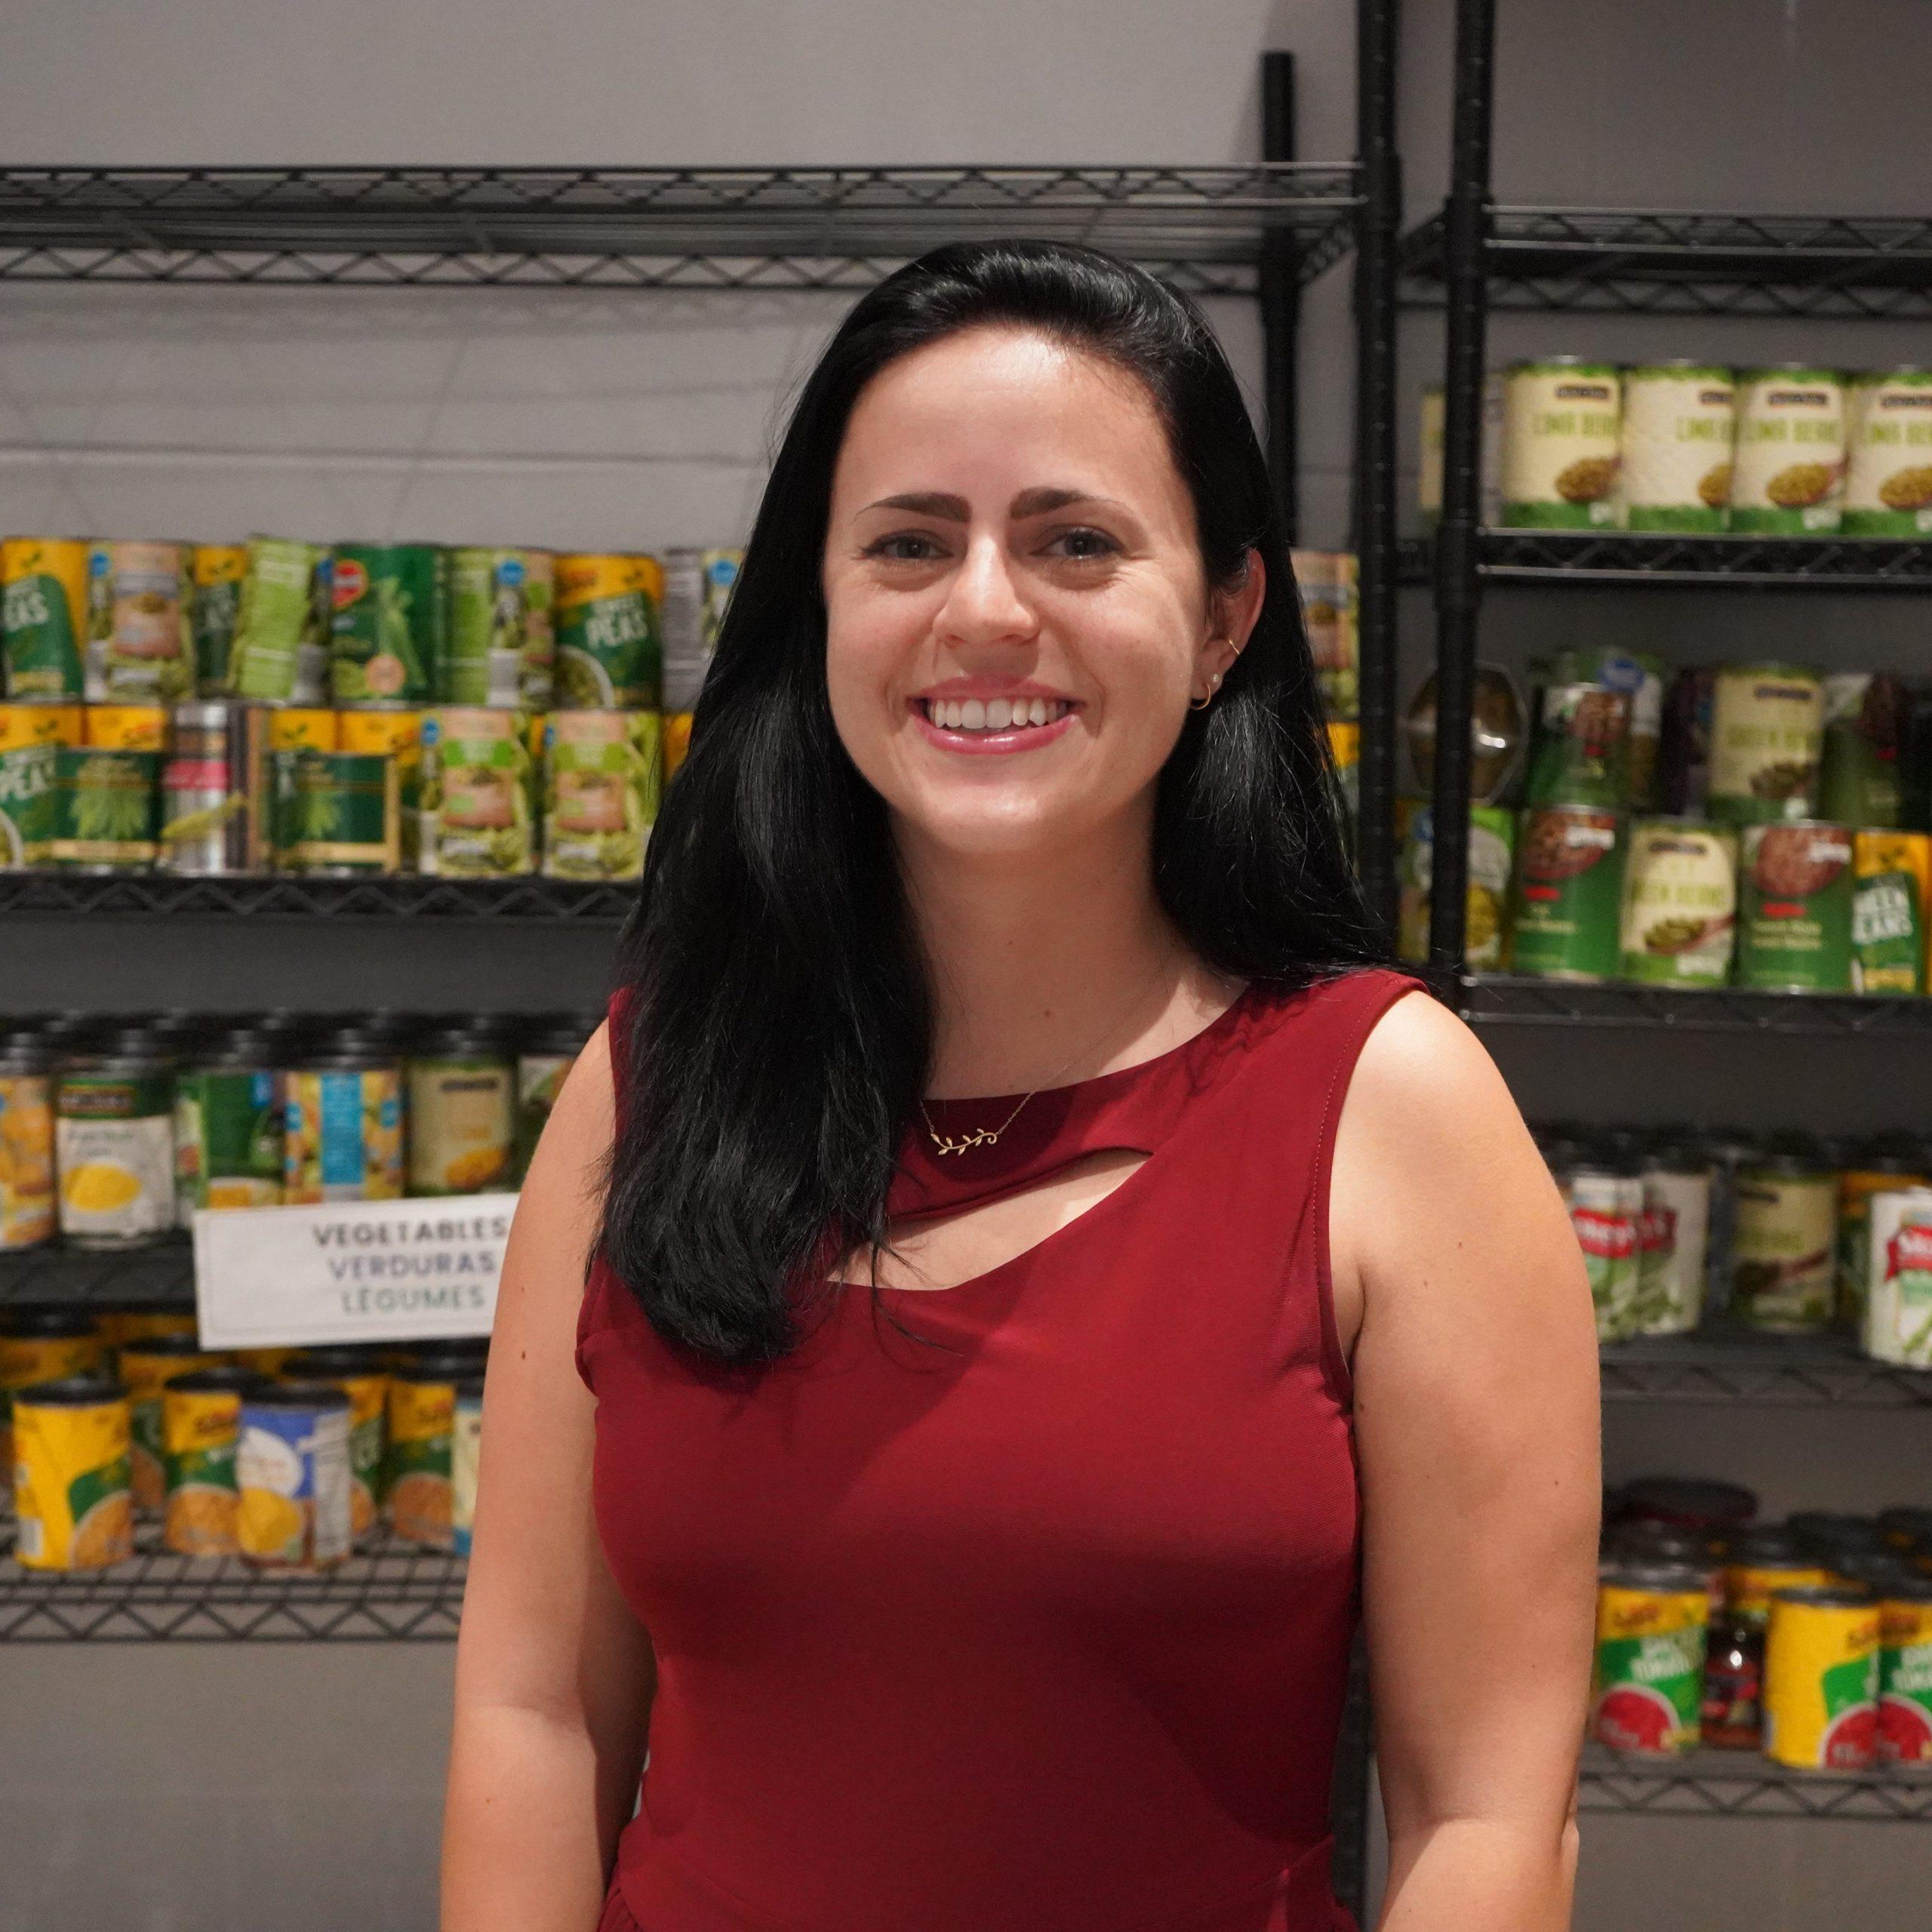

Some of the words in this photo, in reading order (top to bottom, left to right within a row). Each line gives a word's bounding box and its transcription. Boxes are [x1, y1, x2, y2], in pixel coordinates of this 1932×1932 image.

[3, 591, 50, 632] EAS
[585, 608, 648, 650] PEAS
[312, 1216, 509, 1247] VEGETABLES
[326, 1250, 495, 1280] VERDURAS
